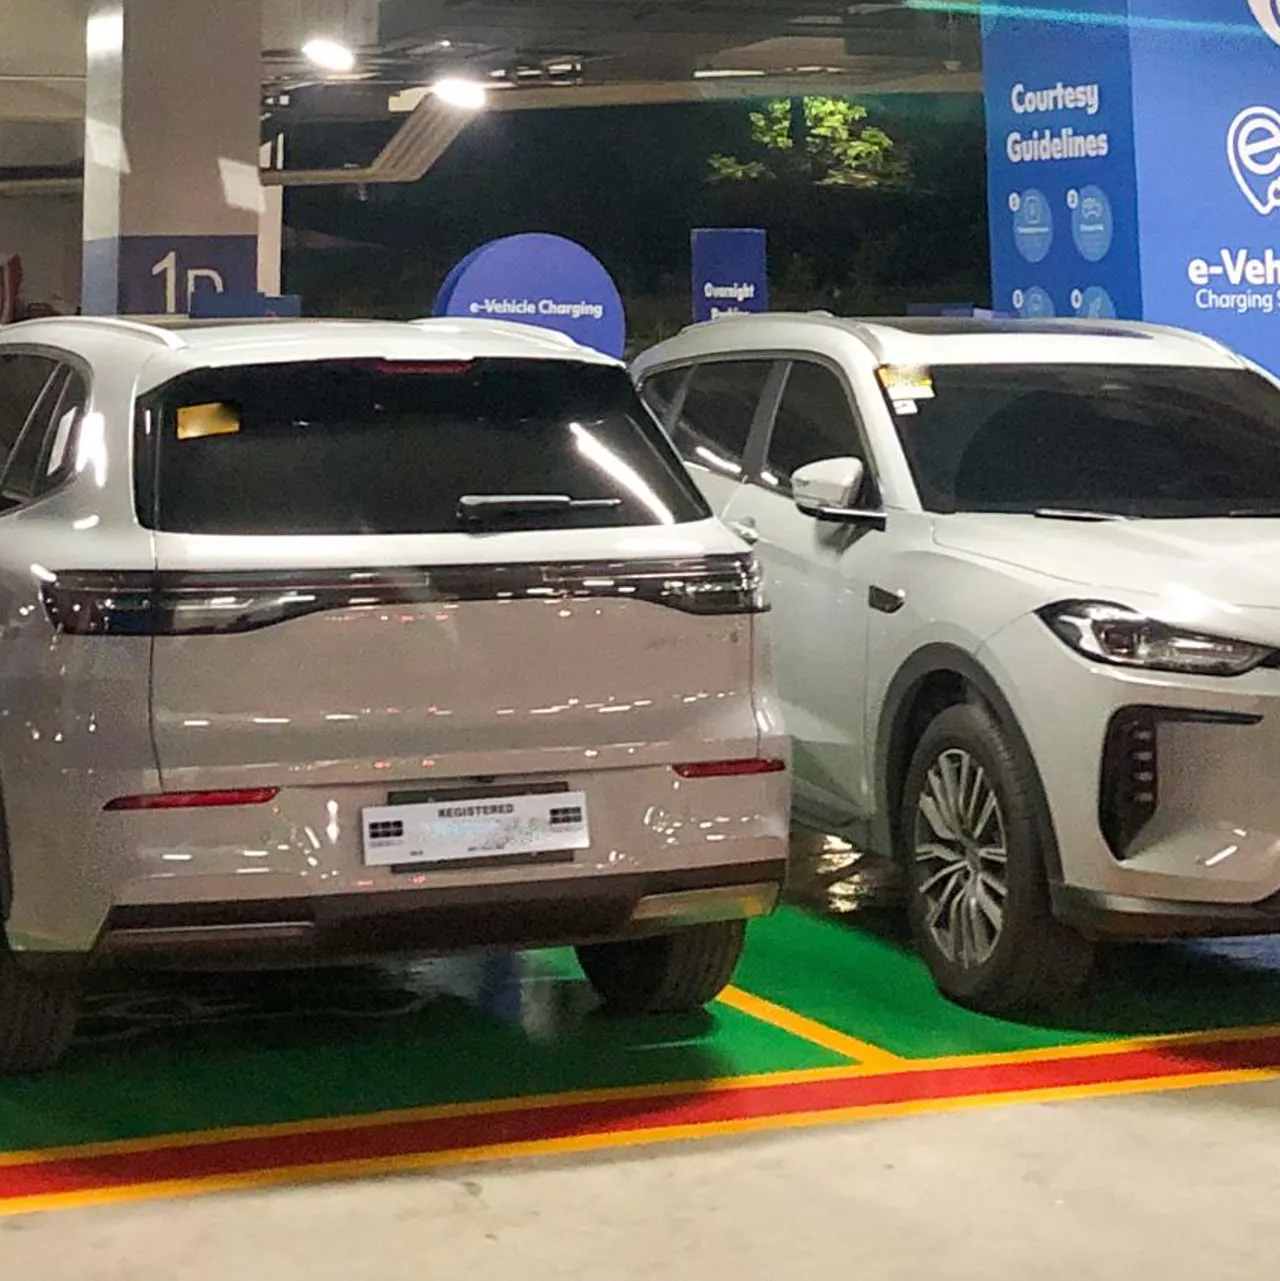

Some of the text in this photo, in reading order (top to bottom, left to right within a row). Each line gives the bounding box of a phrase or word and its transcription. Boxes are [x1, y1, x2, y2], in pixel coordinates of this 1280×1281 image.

[1011, 82, 1099, 115] Courtesy
[1007, 127, 1108, 163] Guidelines
[470, 298, 604, 319] e-Vehicle Charging
[1195, 288, 1273, 312] Charging
[437, 803, 515, 819] REGISTERED
